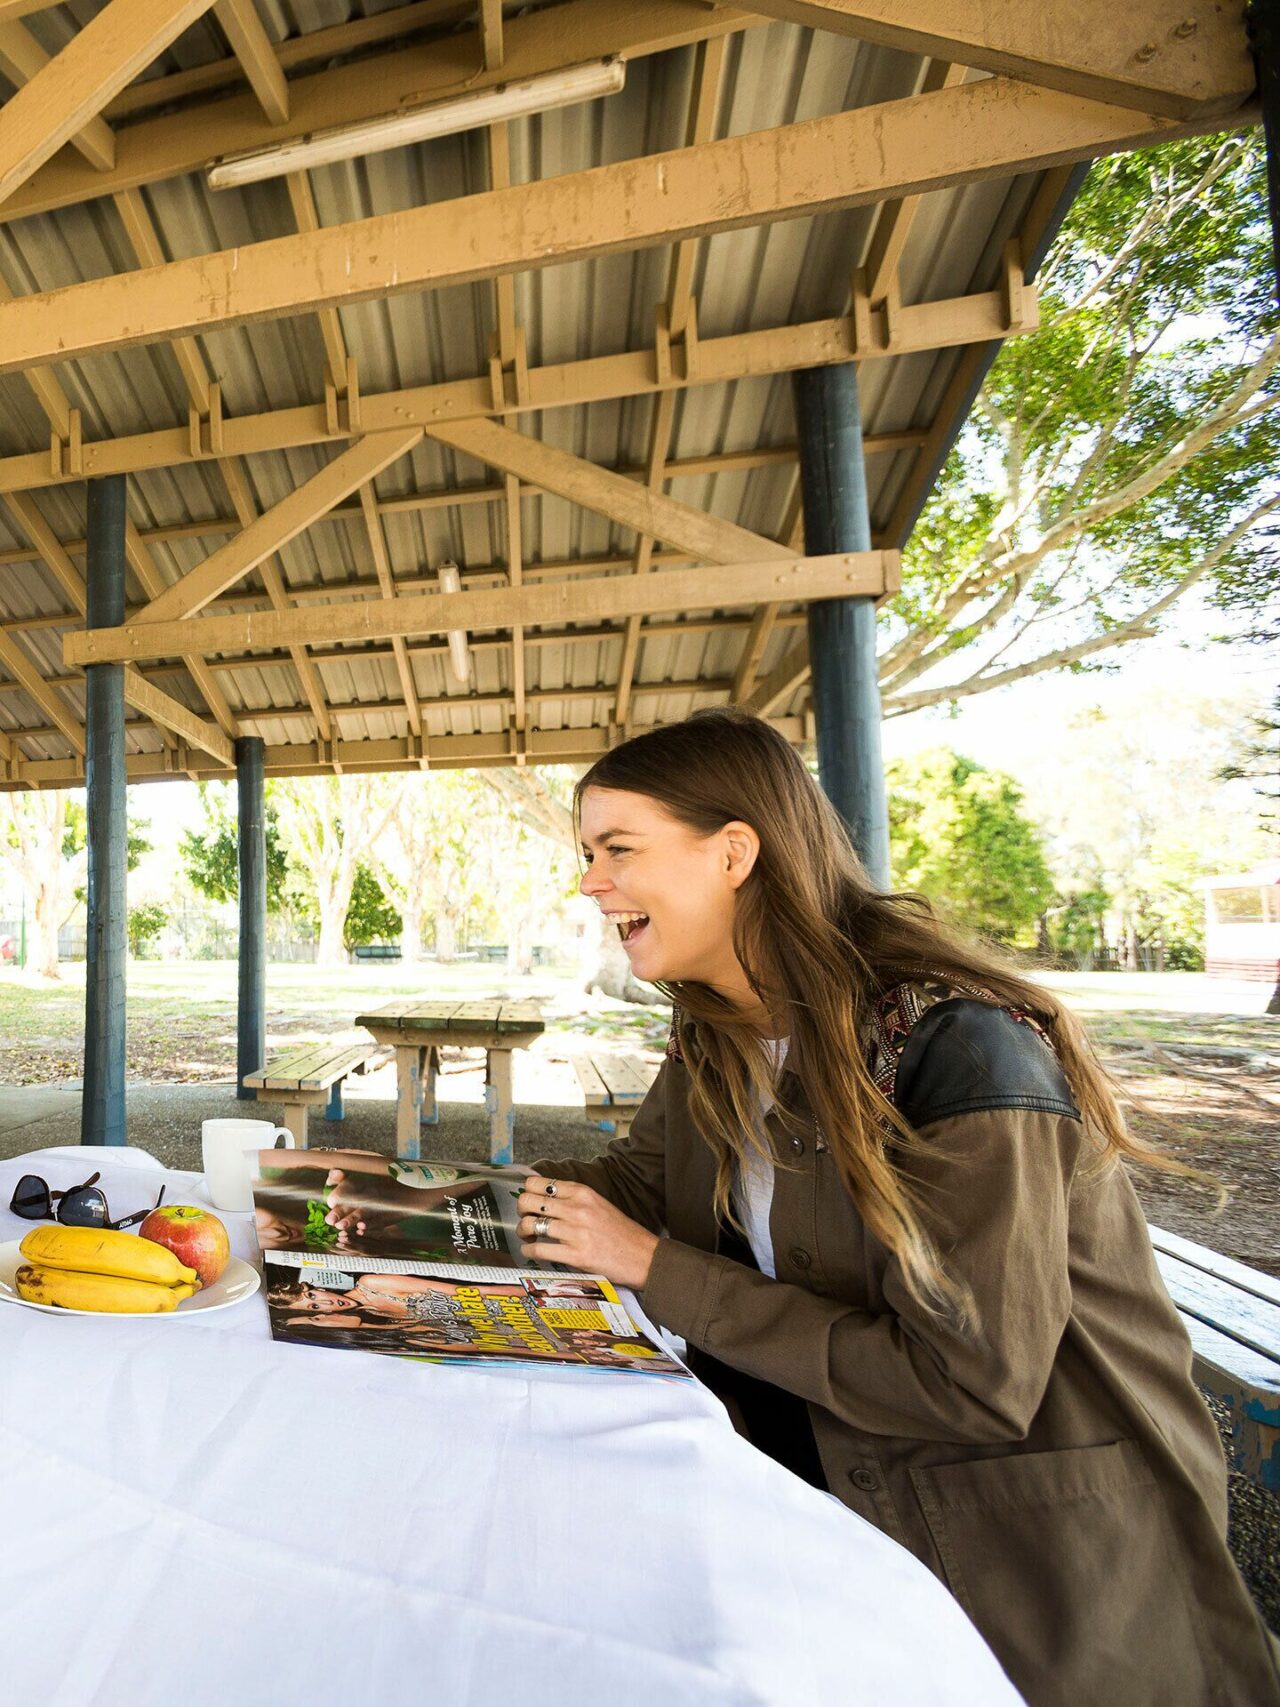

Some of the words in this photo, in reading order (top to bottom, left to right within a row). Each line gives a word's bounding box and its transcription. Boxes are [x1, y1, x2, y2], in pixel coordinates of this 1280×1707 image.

[443, 1195, 458, 1206] of
[460, 1204, 478, 1225] Joy
[447, 1207, 467, 1247] Moment
[466, 1225, 481, 1249] Pure
[451, 1287, 489, 1316] hate
[486, 1295, 538, 1332] other!
[469, 1319, 497, 1331] we
[471, 1332, 513, 1350] Why
[510, 1333, 557, 1353] each
